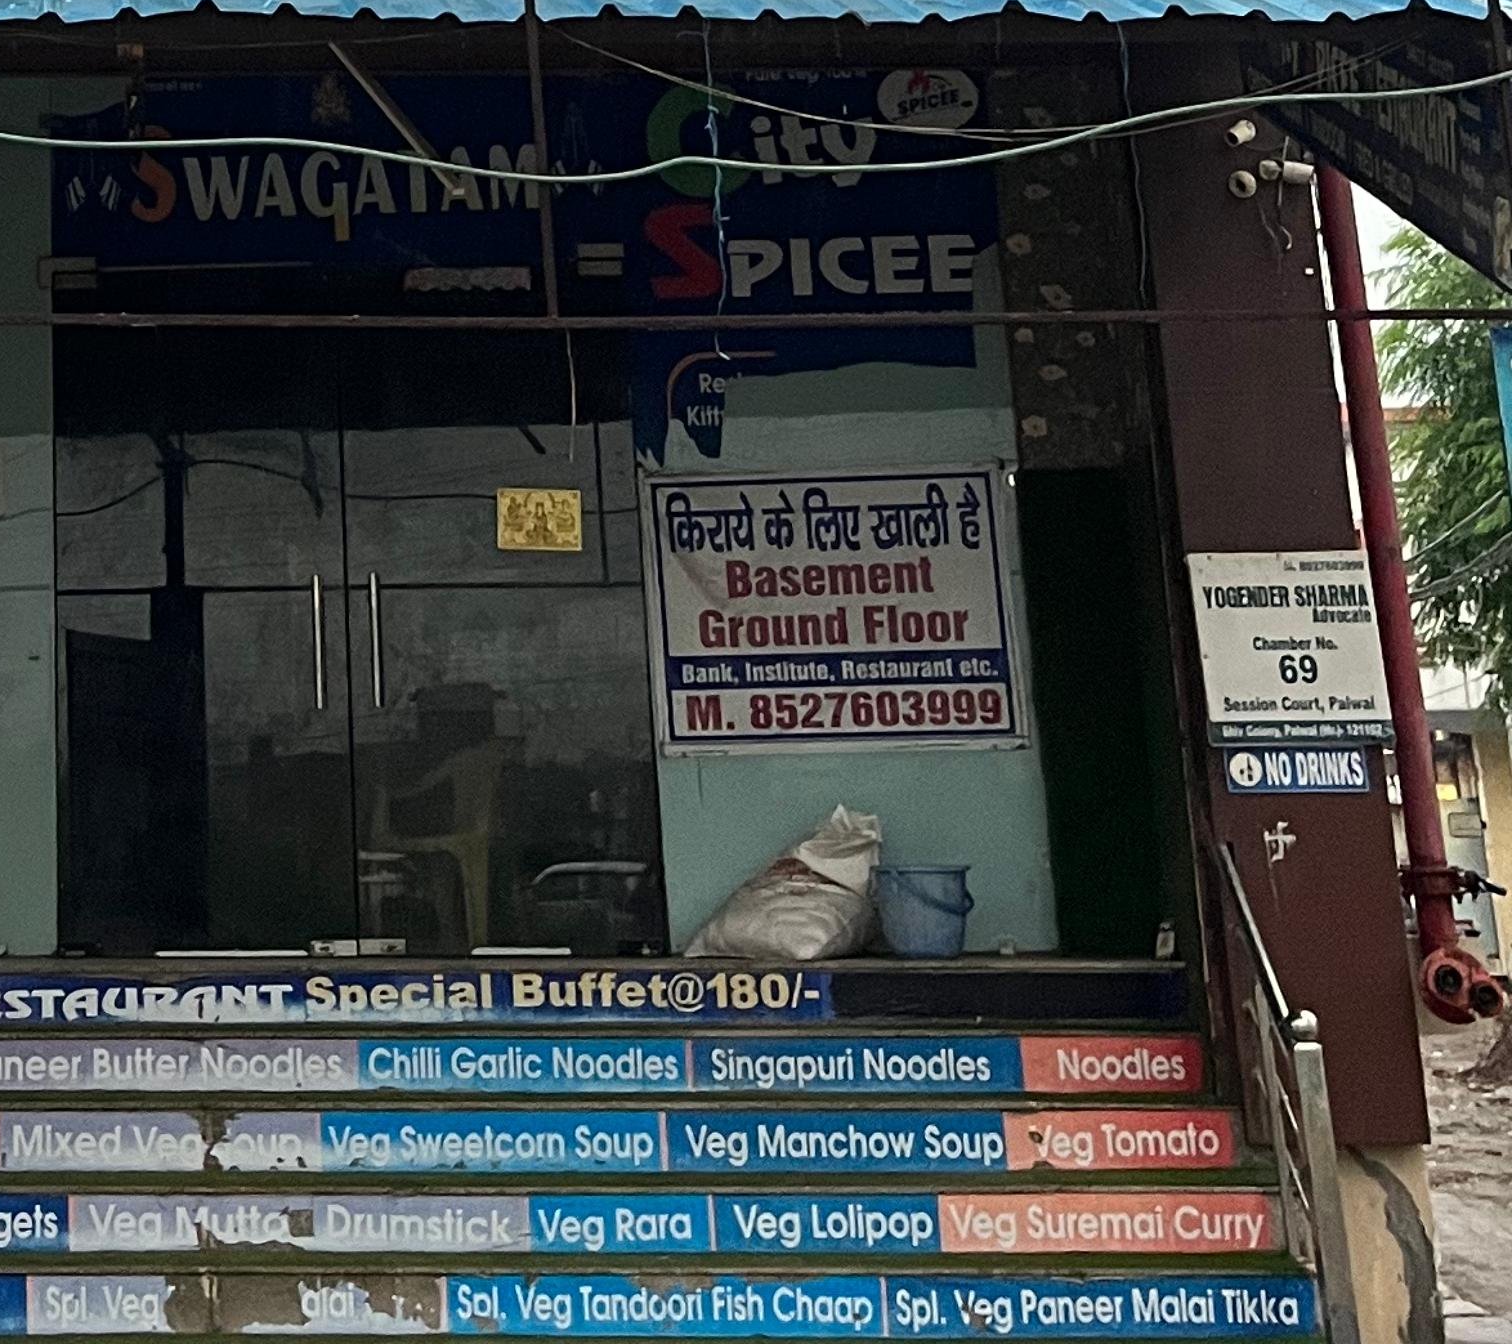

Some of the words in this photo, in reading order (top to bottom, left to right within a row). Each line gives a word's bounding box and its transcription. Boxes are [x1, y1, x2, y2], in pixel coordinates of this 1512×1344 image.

[897, 87, 960, 117] SPICEE
[646, 78, 878, 199] City
[130, 126, 542, 243] SWAGATAM
[643, 199, 976, 303] SPICEE
[686, 405, 725, 428] Kitt
[664, 491, 756, 554] किराये
[761, 490, 795, 551] के
[803, 487, 862, 551] लिए
[868, 483, 949, 550] खाली
[956, 481, 981, 549] है
[725, 556, 935, 600] Basement
[1202, 584, 1290, 609] YOGENDER
[1294, 583, 1369, 607] SHARMA
[698, 606, 849, 649] Ground
[862, 605, 970, 645] Floor
[1252, 636, 1312, 652] Chamber
[1315, 636, 1338, 651] No.
[681, 663, 739, 685] Bank,
[841, 658, 954, 681] Restaurant
[959, 658, 999, 679] etc.
[1278, 654, 1319, 685] 69
[686, 694, 736, 731] M.
[749, 688, 1002, 731] 8527603999
[1223, 696, 1278, 713] Session
[1281, 696, 1325, 715] Court,
[1264, 751, 1292, 787] NO
[1294, 751, 1365, 787] DRINKS
[305, 973, 493, 1016] Special
[93, 1046, 189, 1080] Butter
[201, 1046, 343, 1081] Noodles
[367, 1046, 442, 1080] Chilli
[450, 1047, 542, 1080] Garlic
[552, 1047, 679, 1080] Noodles
[711, 1047, 854, 1089] Singapuri
[863, 1047, 991, 1082] Noodles
[1057, 1047, 1187, 1081] Noodles
[11, 1123, 122, 1159] Mixed
[223, 1127, 303, 1166] oup
[327, 1125, 390, 1165] Veg
[398, 1124, 566, 1161] Sweetcorn
[574, 1124, 654, 1165] Soup
[686, 1125, 748, 1167] Veg
[756, 1124, 915, 1160] Manchow
[924, 1124, 1004, 1166] Soup
[1028, 1124, 1094, 1166] Veg
[1100, 1121, 1221, 1158] Tomato
[175, 1204, 303, 1238] Mutto
[325, 1203, 513, 1243] Drumstick
[538, 1208, 605, 1251] Veg
[614, 1207, 692, 1242] Rara
[733, 1204, 802, 1248] Veg
[811, 1203, 934, 1249] Lolipop
[949, 1204, 1017, 1247] Veg
[1026, 1204, 1164, 1241] Suremai
[1174, 1205, 1265, 1250] Curry
[515, 1288, 572, 1329] Veg
[579, 1286, 703, 1323] Tandoori
[712, 1286, 764, 1323] Fish
[772, 1287, 874, 1330] Chaap
[895, 1288, 946, 1331] Spl.
[953, 1291, 1014, 1331] Veg
[1019, 1288, 1123, 1325] Paneer
[1132, 1288, 1215, 1324] Malai
[1221, 1288, 1300, 1326] Tikka
